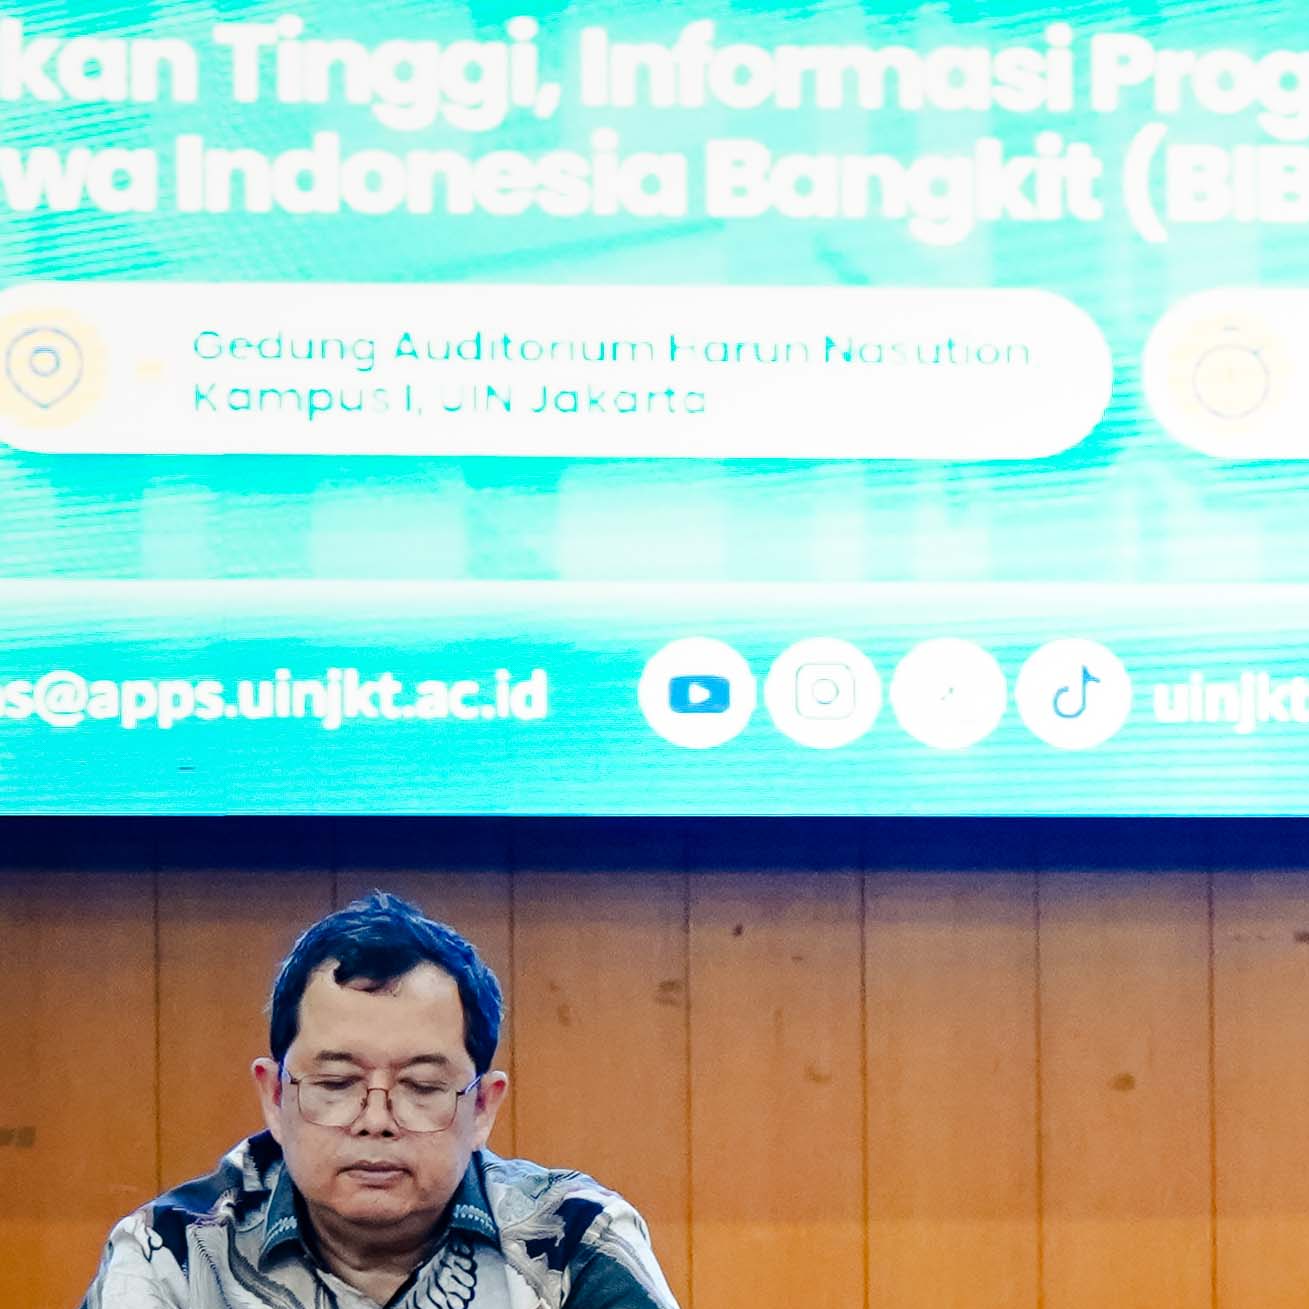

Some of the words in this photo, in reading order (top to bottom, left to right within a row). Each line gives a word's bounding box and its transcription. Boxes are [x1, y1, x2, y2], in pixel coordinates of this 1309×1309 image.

[0, 17, 198, 102] kan
[213, 15, 561, 131] Tinggi,
[580, 20, 1074, 111] Informasi
[0, 147, 158, 212] wa
[174, 128, 688, 215] Indonesia
[705, 131, 1103, 246] Bangkit
[193, 329, 376, 372] Gedung
[394, 330, 654, 362] Auditorium
[669, 333, 810, 364] Harun
[194, 383, 390, 421] Kampus
[530, 384, 706, 414] Jakarta
[0, 668, 548, 730] s@apps.uinjkt.ac.id
